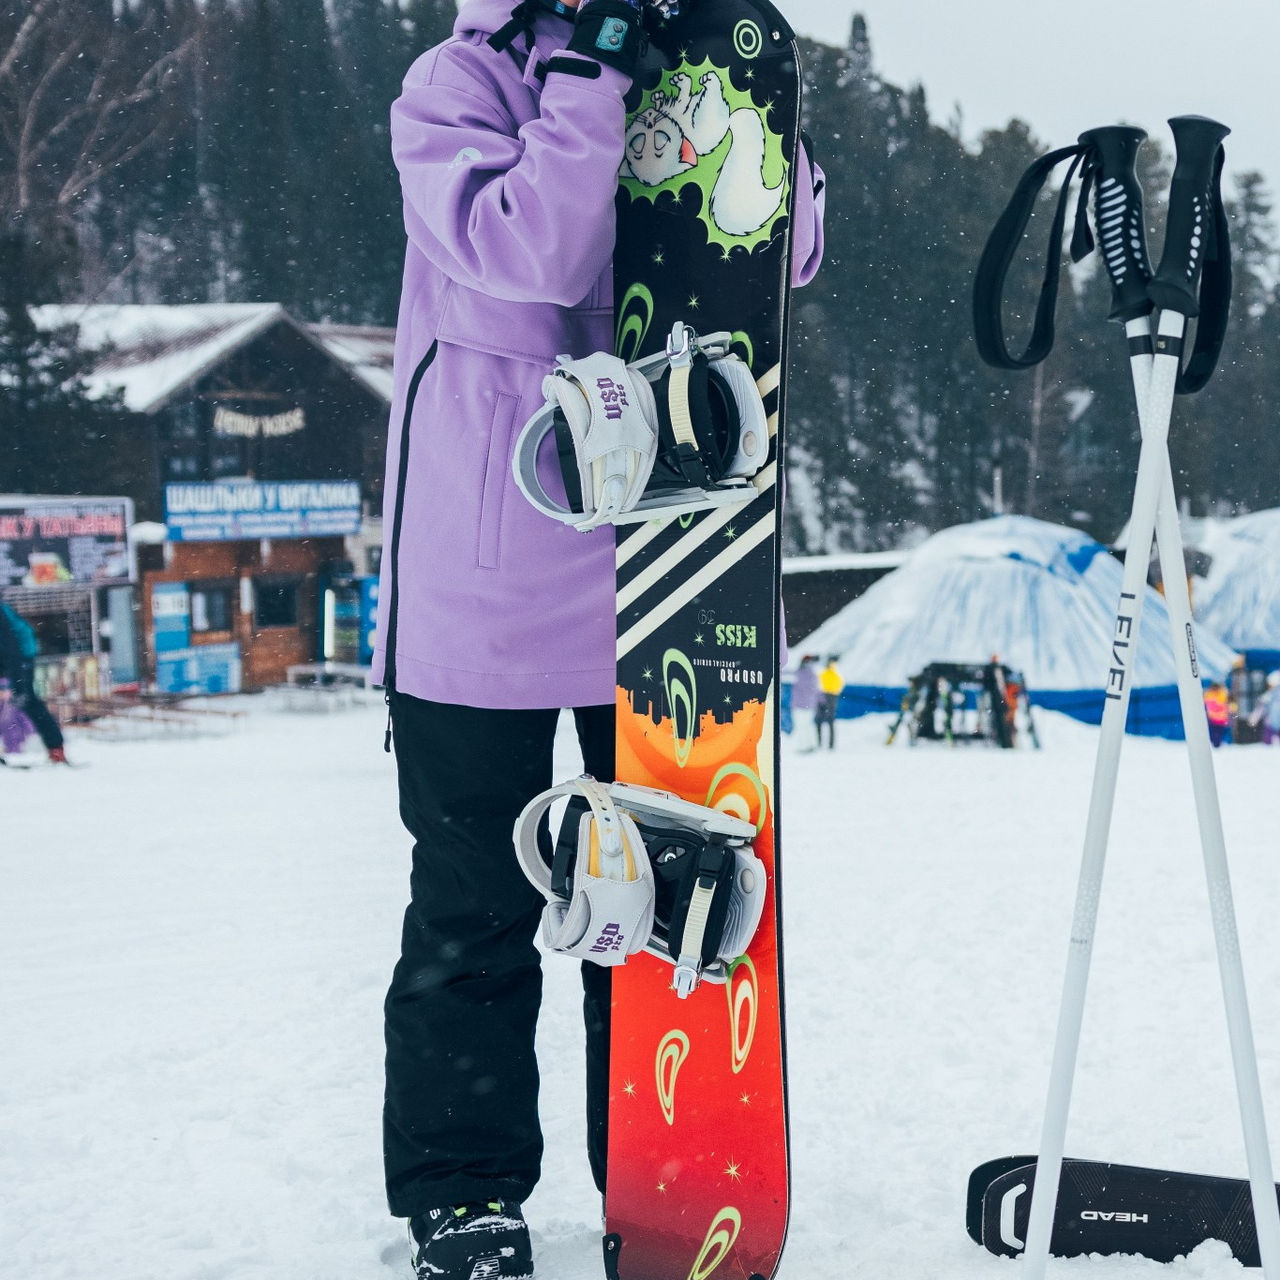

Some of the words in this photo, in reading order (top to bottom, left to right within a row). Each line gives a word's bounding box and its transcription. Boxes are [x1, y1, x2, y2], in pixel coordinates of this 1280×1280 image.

[166, 484, 264, 513] ШАШЛЫКИ
[265, 484, 277, 511] У
[715, 624, 757, 648] KISS
[712, 660, 736, 669] SPECIAL
[720, 668, 740, 683] PRO
[742, 669, 763, 685] USD
[1080, 1210, 1148, 1223] HEAD
